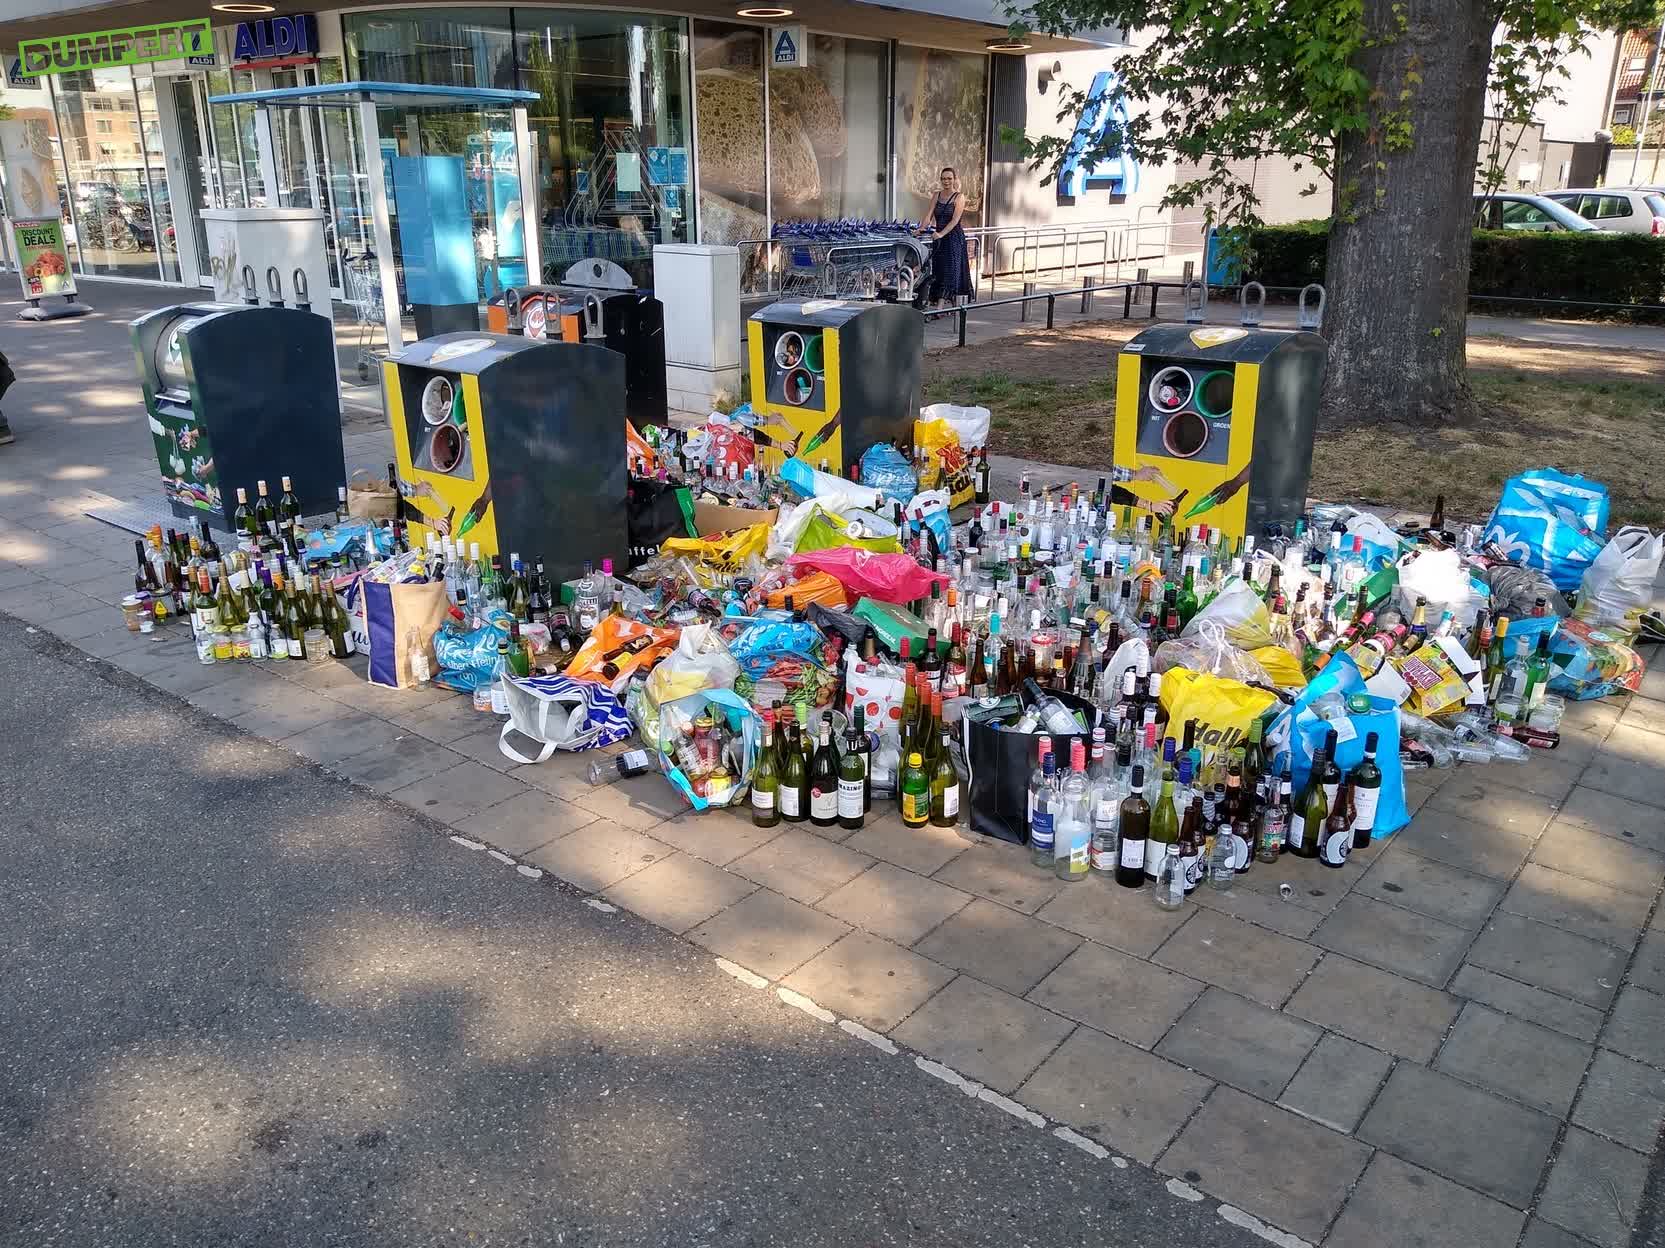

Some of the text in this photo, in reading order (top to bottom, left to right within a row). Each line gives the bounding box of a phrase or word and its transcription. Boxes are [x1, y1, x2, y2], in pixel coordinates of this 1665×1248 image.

[234, 15, 309, 59] ALDI
[190, 57, 215, 66] ALDI
[777, 54, 795, 62] ALDI
[11, 77, 35, 86] ALDI
[21, 228, 54, 236] DISCOUNT
[24, 235, 56, 246] DEALS
